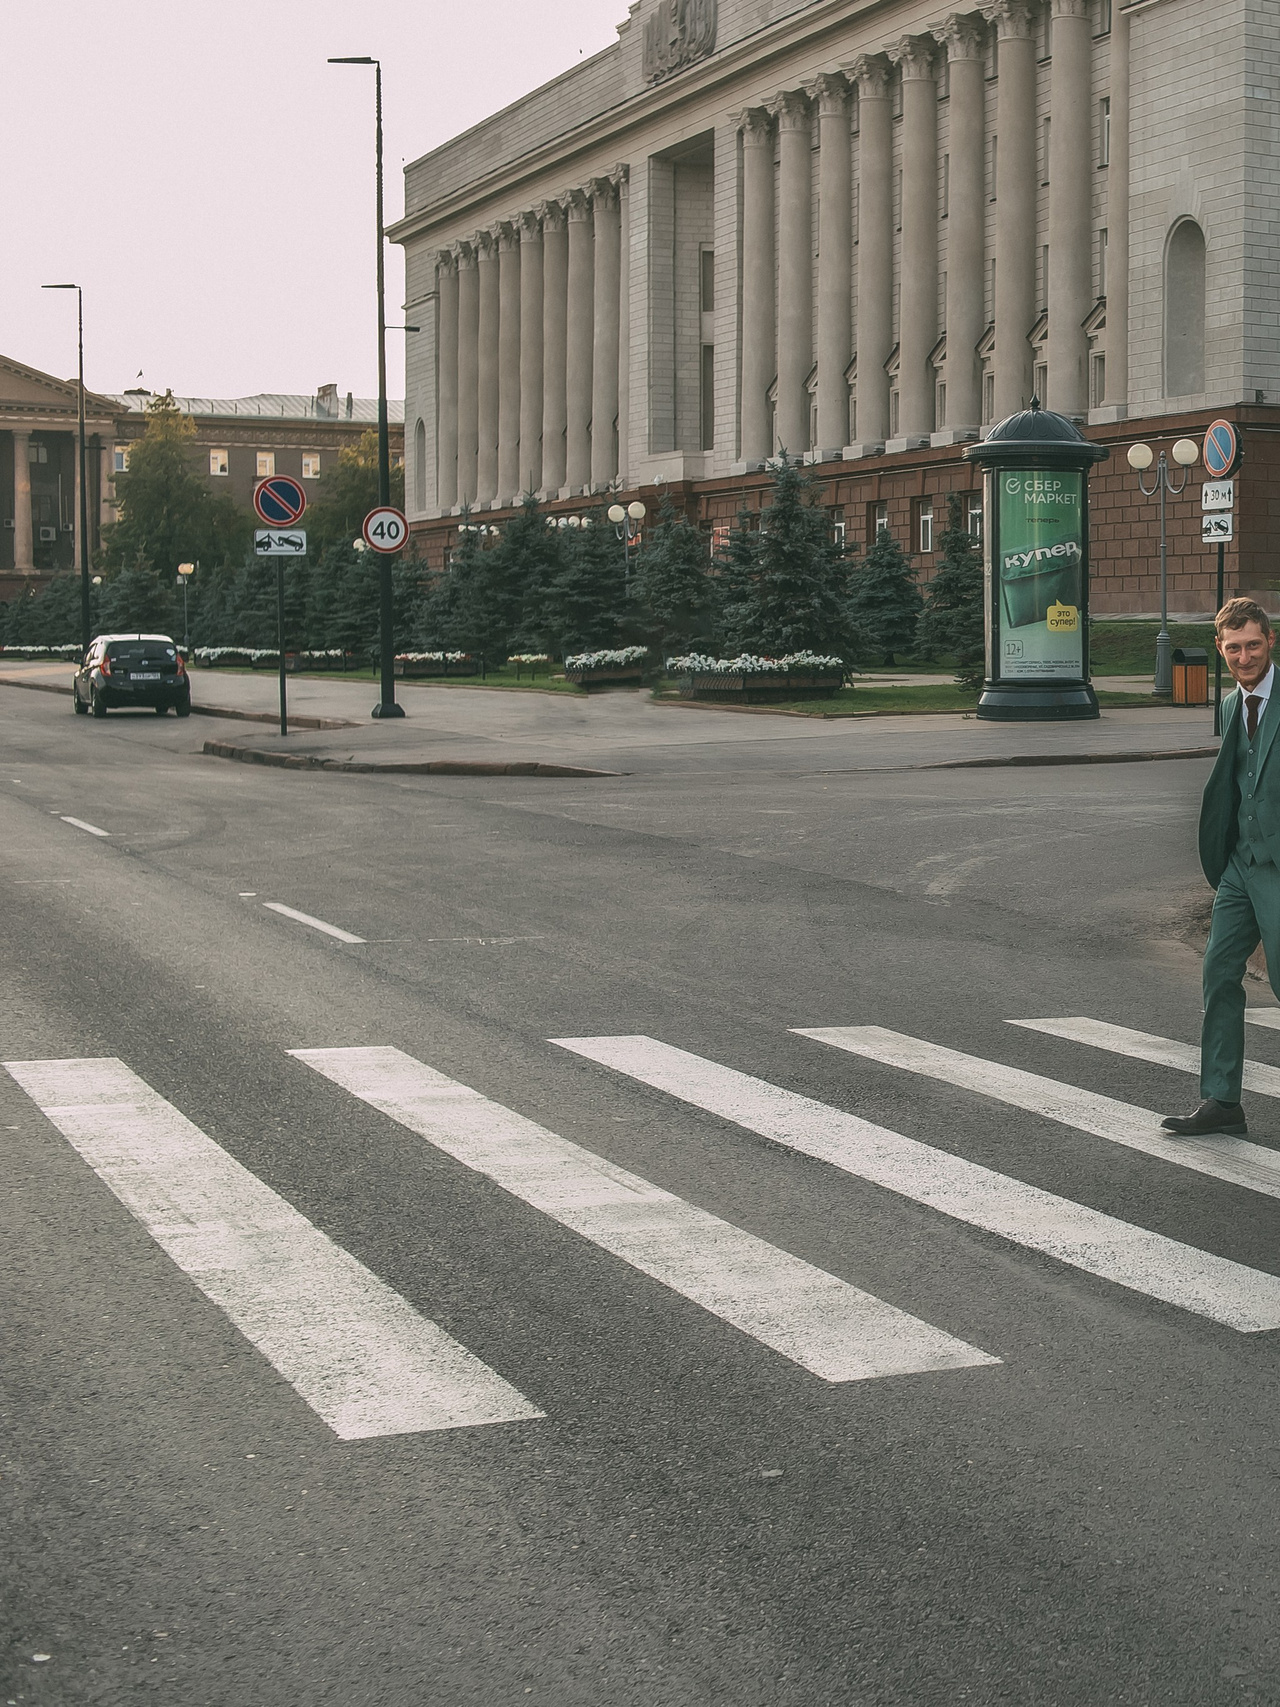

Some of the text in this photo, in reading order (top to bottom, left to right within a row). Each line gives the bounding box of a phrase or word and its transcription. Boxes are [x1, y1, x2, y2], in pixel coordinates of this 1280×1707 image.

[1024, 480, 1061, 491] СБЕР
[1024, 493, 1077, 504] МАРКЕТ
[1211, 490, 1219, 501] 30
[372, 520, 400, 540] 40
[1004, 541, 1077, 569] купер
[1050, 617, 1076, 627] супер!
[1006, 643, 1021, 655] 12+
